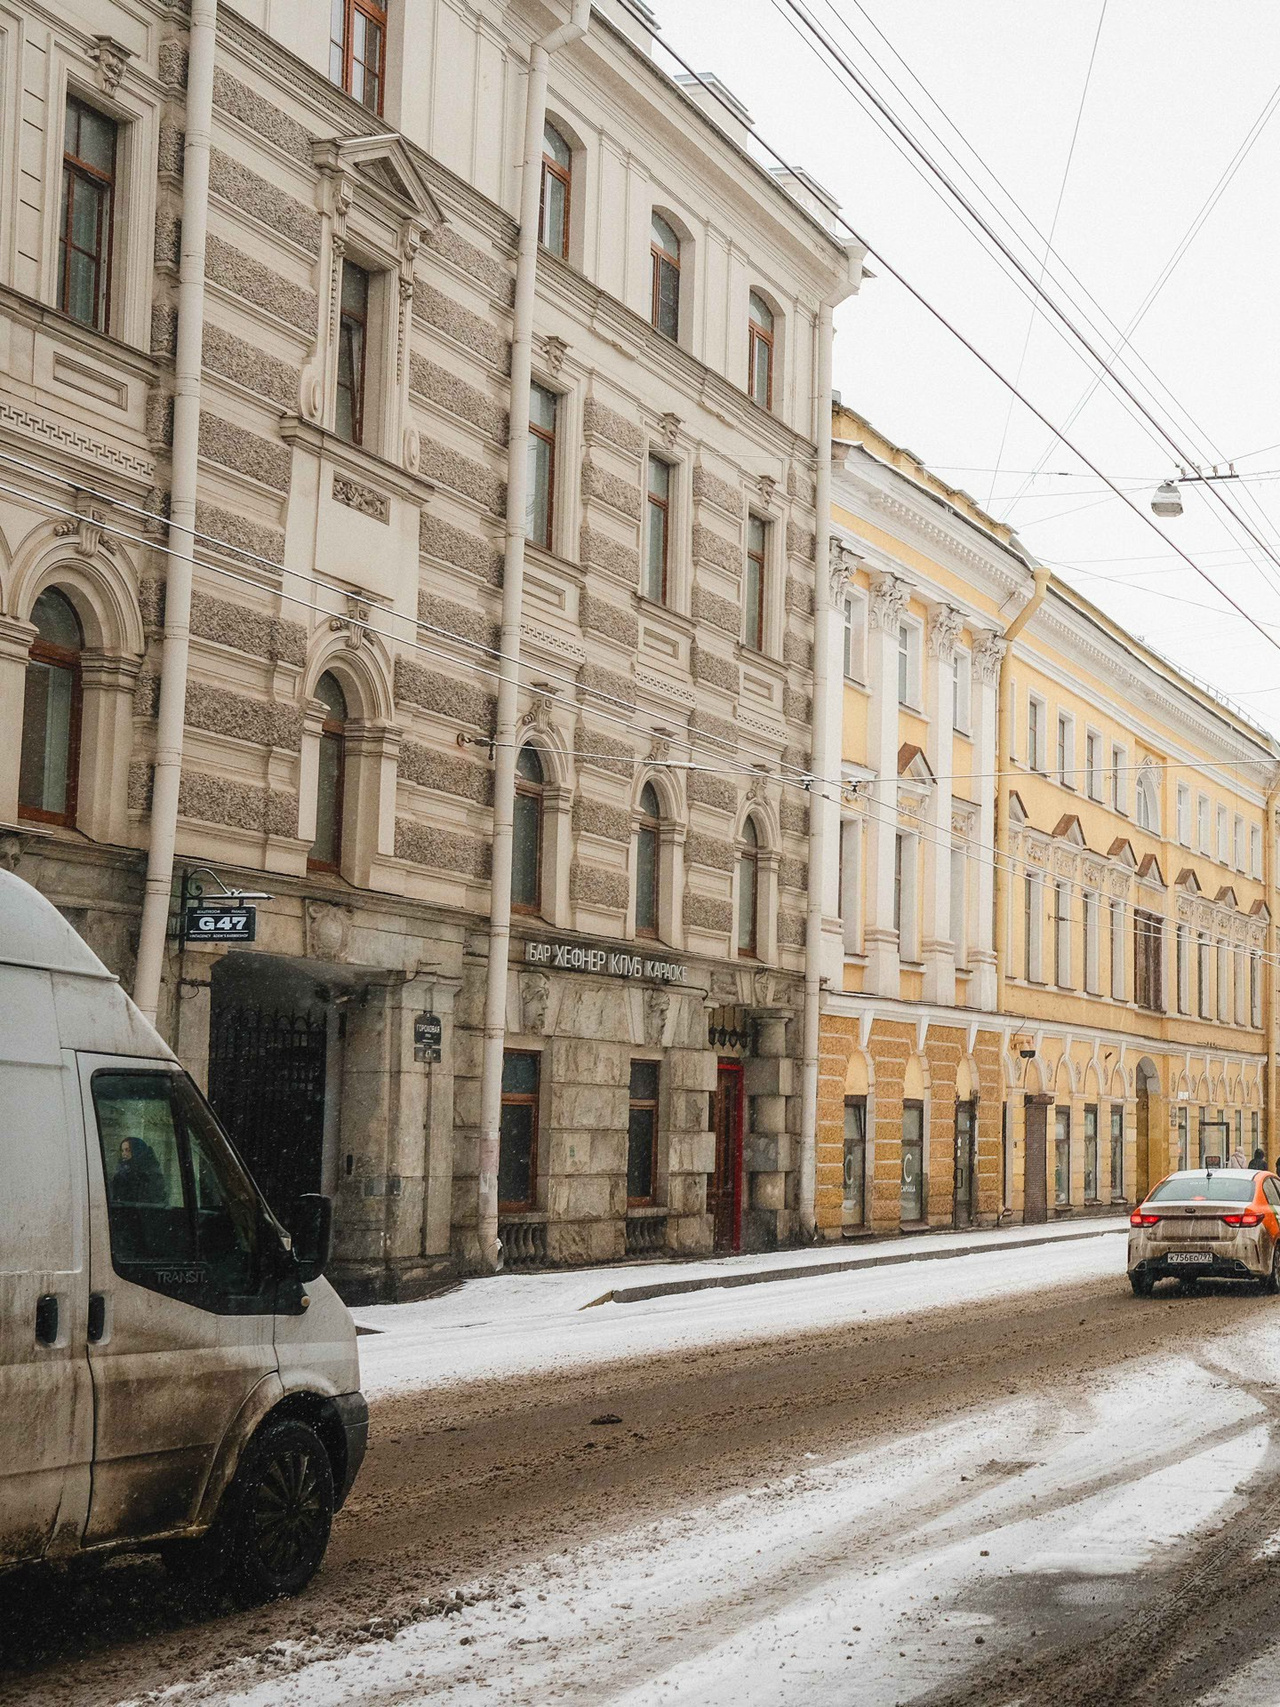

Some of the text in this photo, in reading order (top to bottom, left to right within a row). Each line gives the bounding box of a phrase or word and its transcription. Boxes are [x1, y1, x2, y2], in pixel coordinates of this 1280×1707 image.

[198, 916, 247, 931] G47
[529, 942, 688, 982] БАР ХЕФНЕР КЛУБ КАРАОКЕ
[156, 1269, 206, 1284] TRANSIT
